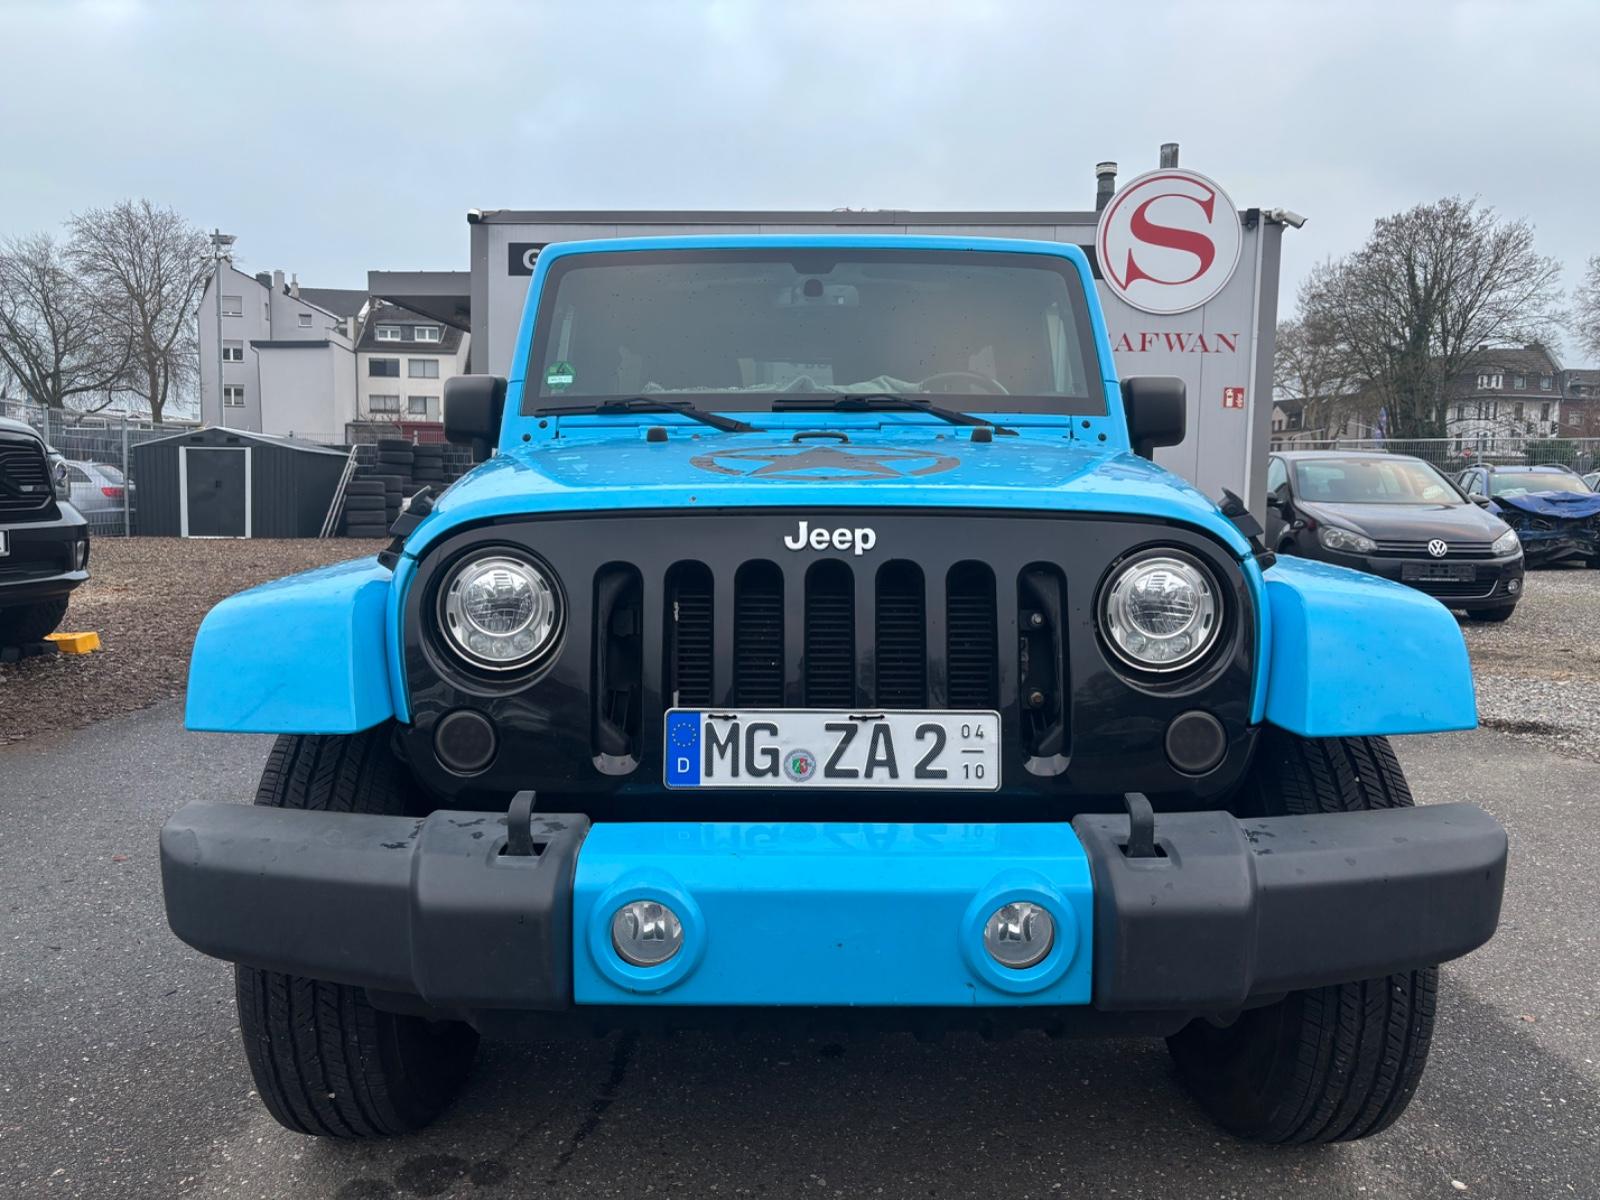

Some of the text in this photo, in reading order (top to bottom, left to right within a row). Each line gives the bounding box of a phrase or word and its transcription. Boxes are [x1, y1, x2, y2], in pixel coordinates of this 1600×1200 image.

[1103, 175, 1217, 291] S
[1108, 332, 1240, 353] AFWAN
[784, 520, 877, 556] Jeep
[961, 723, 985, 739] 04
[704, 721, 780, 778] MG
[824, 722, 899, 779] ZA
[914, 723, 948, 780] 2
[677, 757, 690, 773] D
[962, 763, 985, 780] 10
